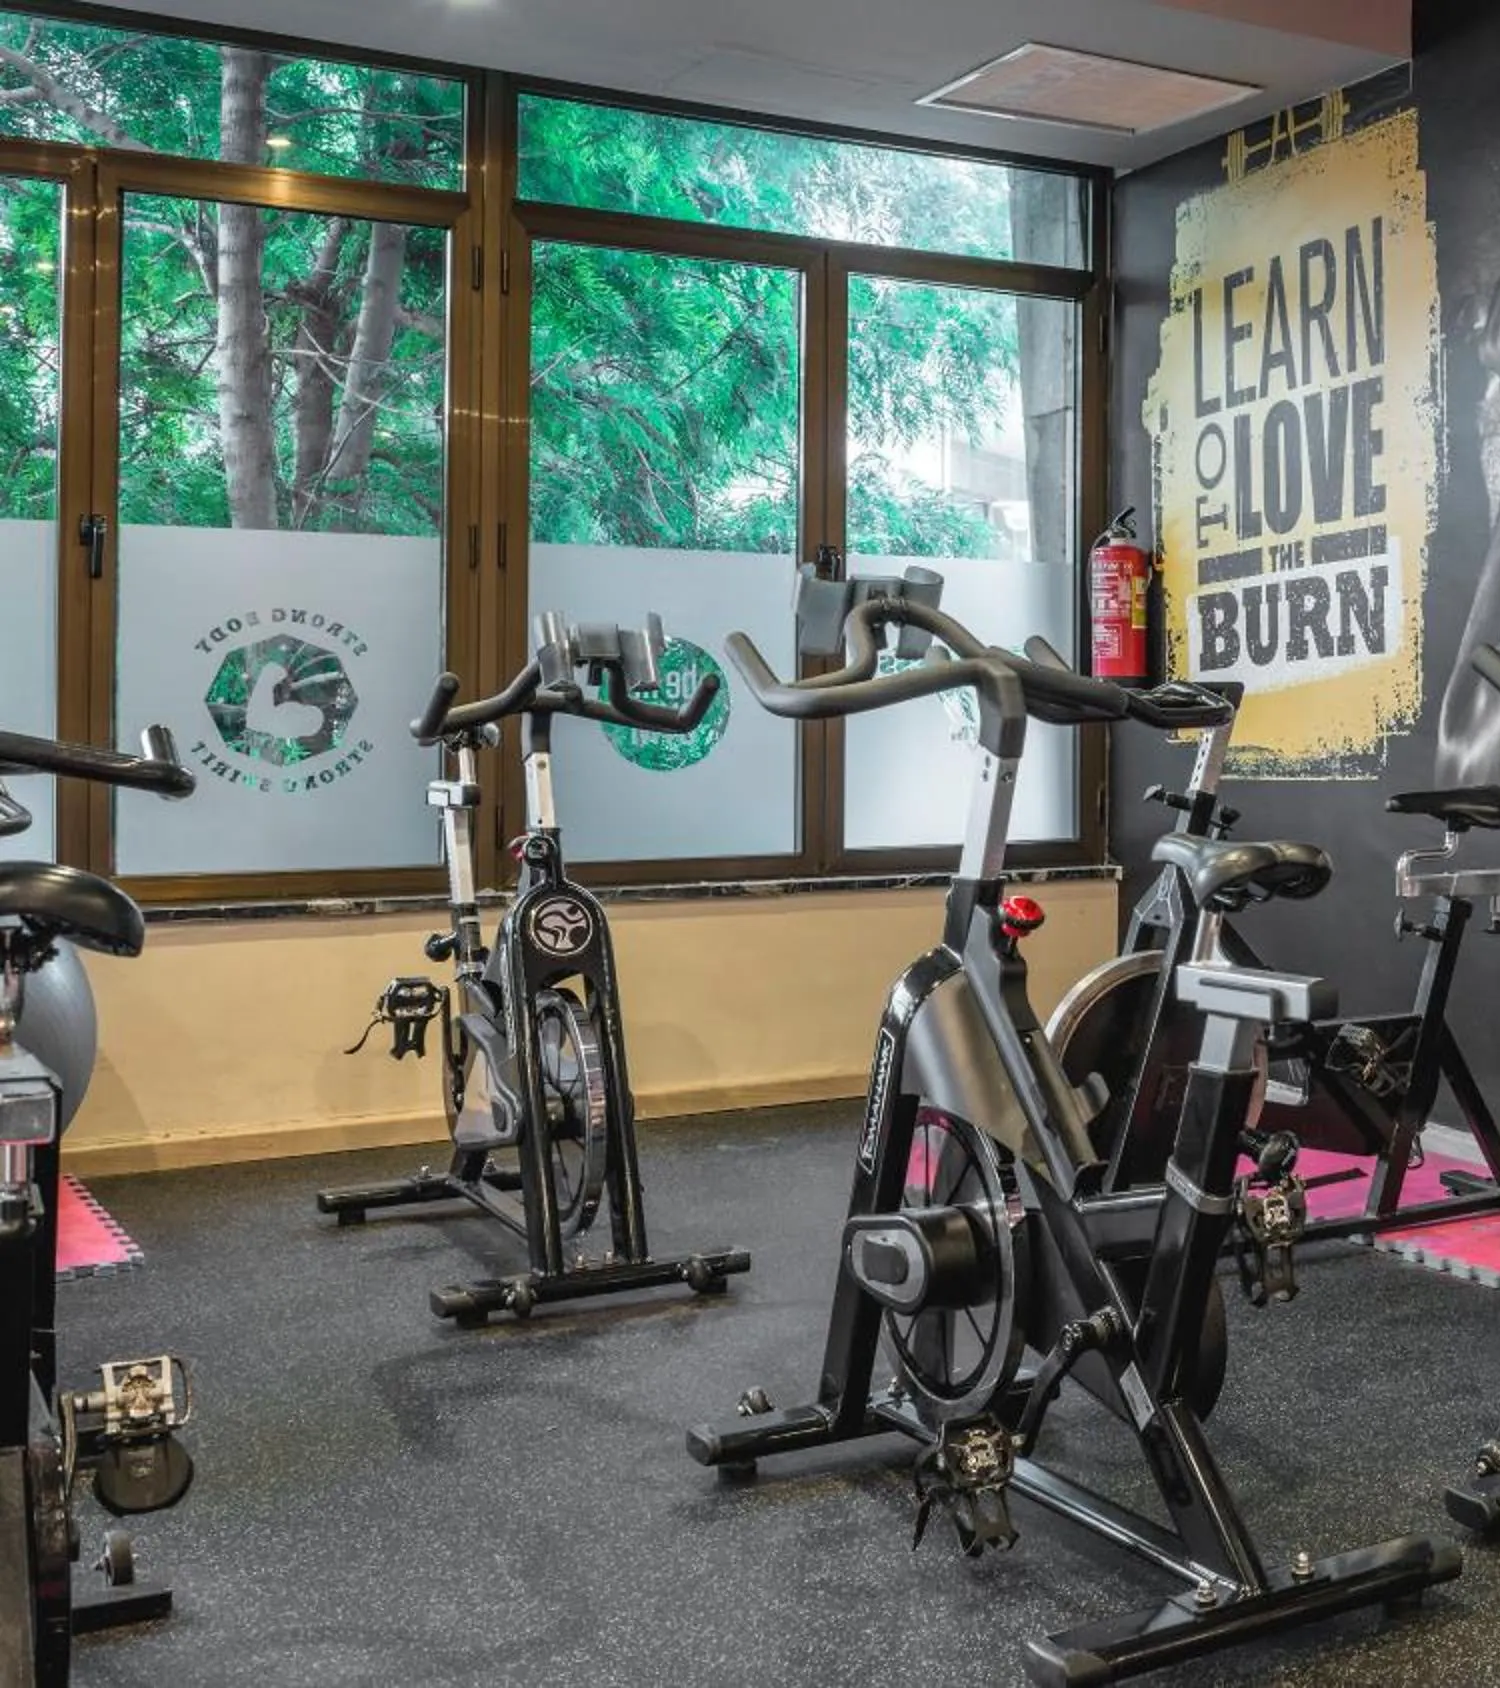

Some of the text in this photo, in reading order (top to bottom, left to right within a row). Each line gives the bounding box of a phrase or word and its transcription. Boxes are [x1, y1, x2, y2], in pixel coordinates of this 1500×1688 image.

[1193, 216, 1384, 419] LEARN
[1194, 422, 1229, 548] TO
[1234, 376, 1387, 541] LOVE
[1269, 542, 1305, 570] THE
[1197, 566, 1389, 673] BURN
